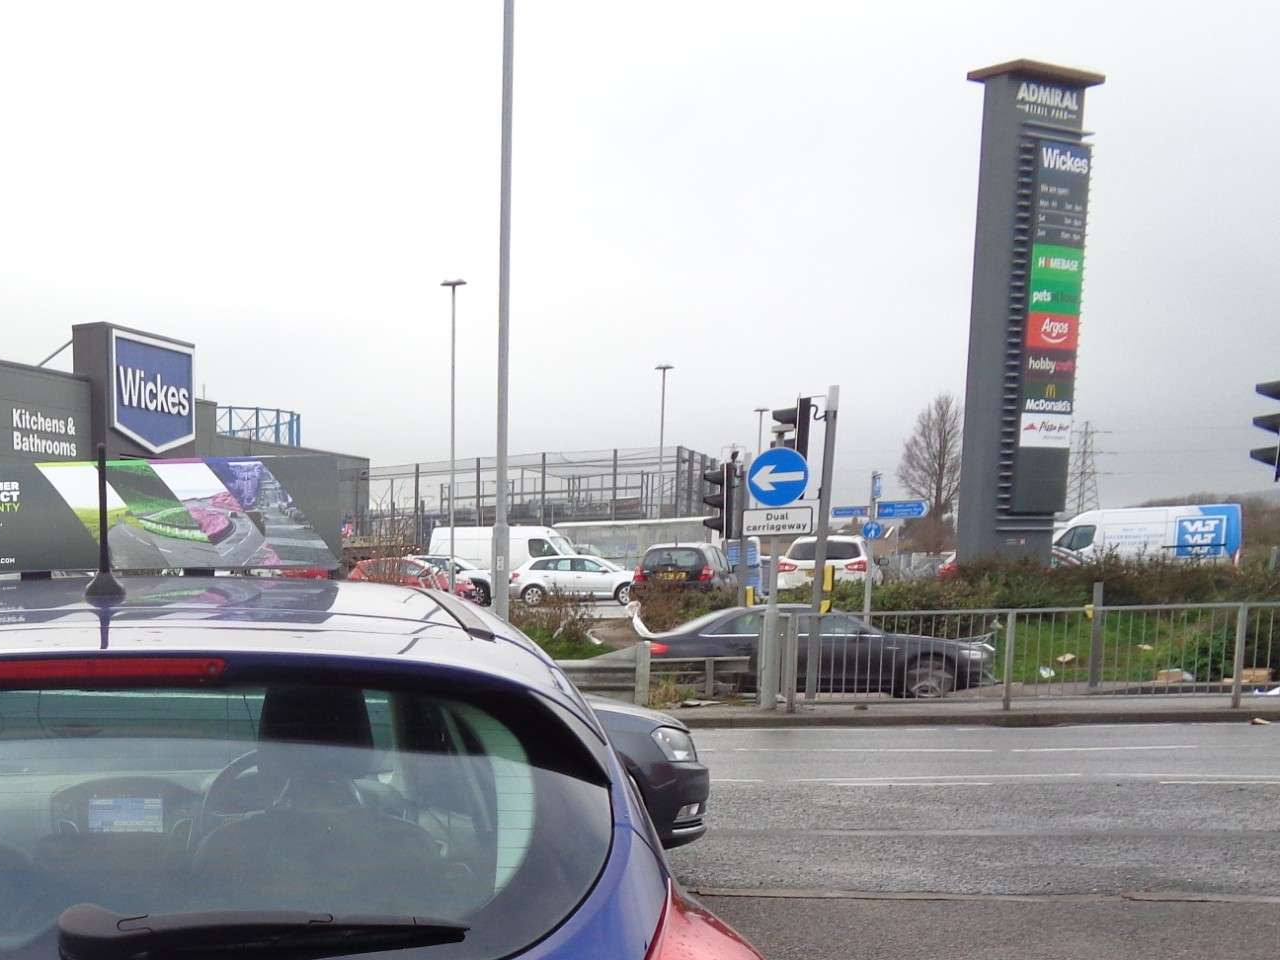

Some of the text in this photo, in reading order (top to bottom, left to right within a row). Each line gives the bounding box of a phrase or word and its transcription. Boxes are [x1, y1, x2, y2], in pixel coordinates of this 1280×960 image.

[1016, 82, 1078, 110] ADMIRAL
[1042, 146, 1088, 174] Wickes
[1038, 256, 1079, 271] HOMEBASE
[1032, 289, 1052, 304] pets
[1041, 317, 1069, 337] Argos
[119, 365, 190, 417] Wickes
[1025, 398, 1071, 412] McDonald's
[13, 408, 76, 436] Kitchens &
[13, 431, 77, 457] Bathrooms
[766, 512, 789, 521] Dual
[746, 522, 807, 532] carriageway
